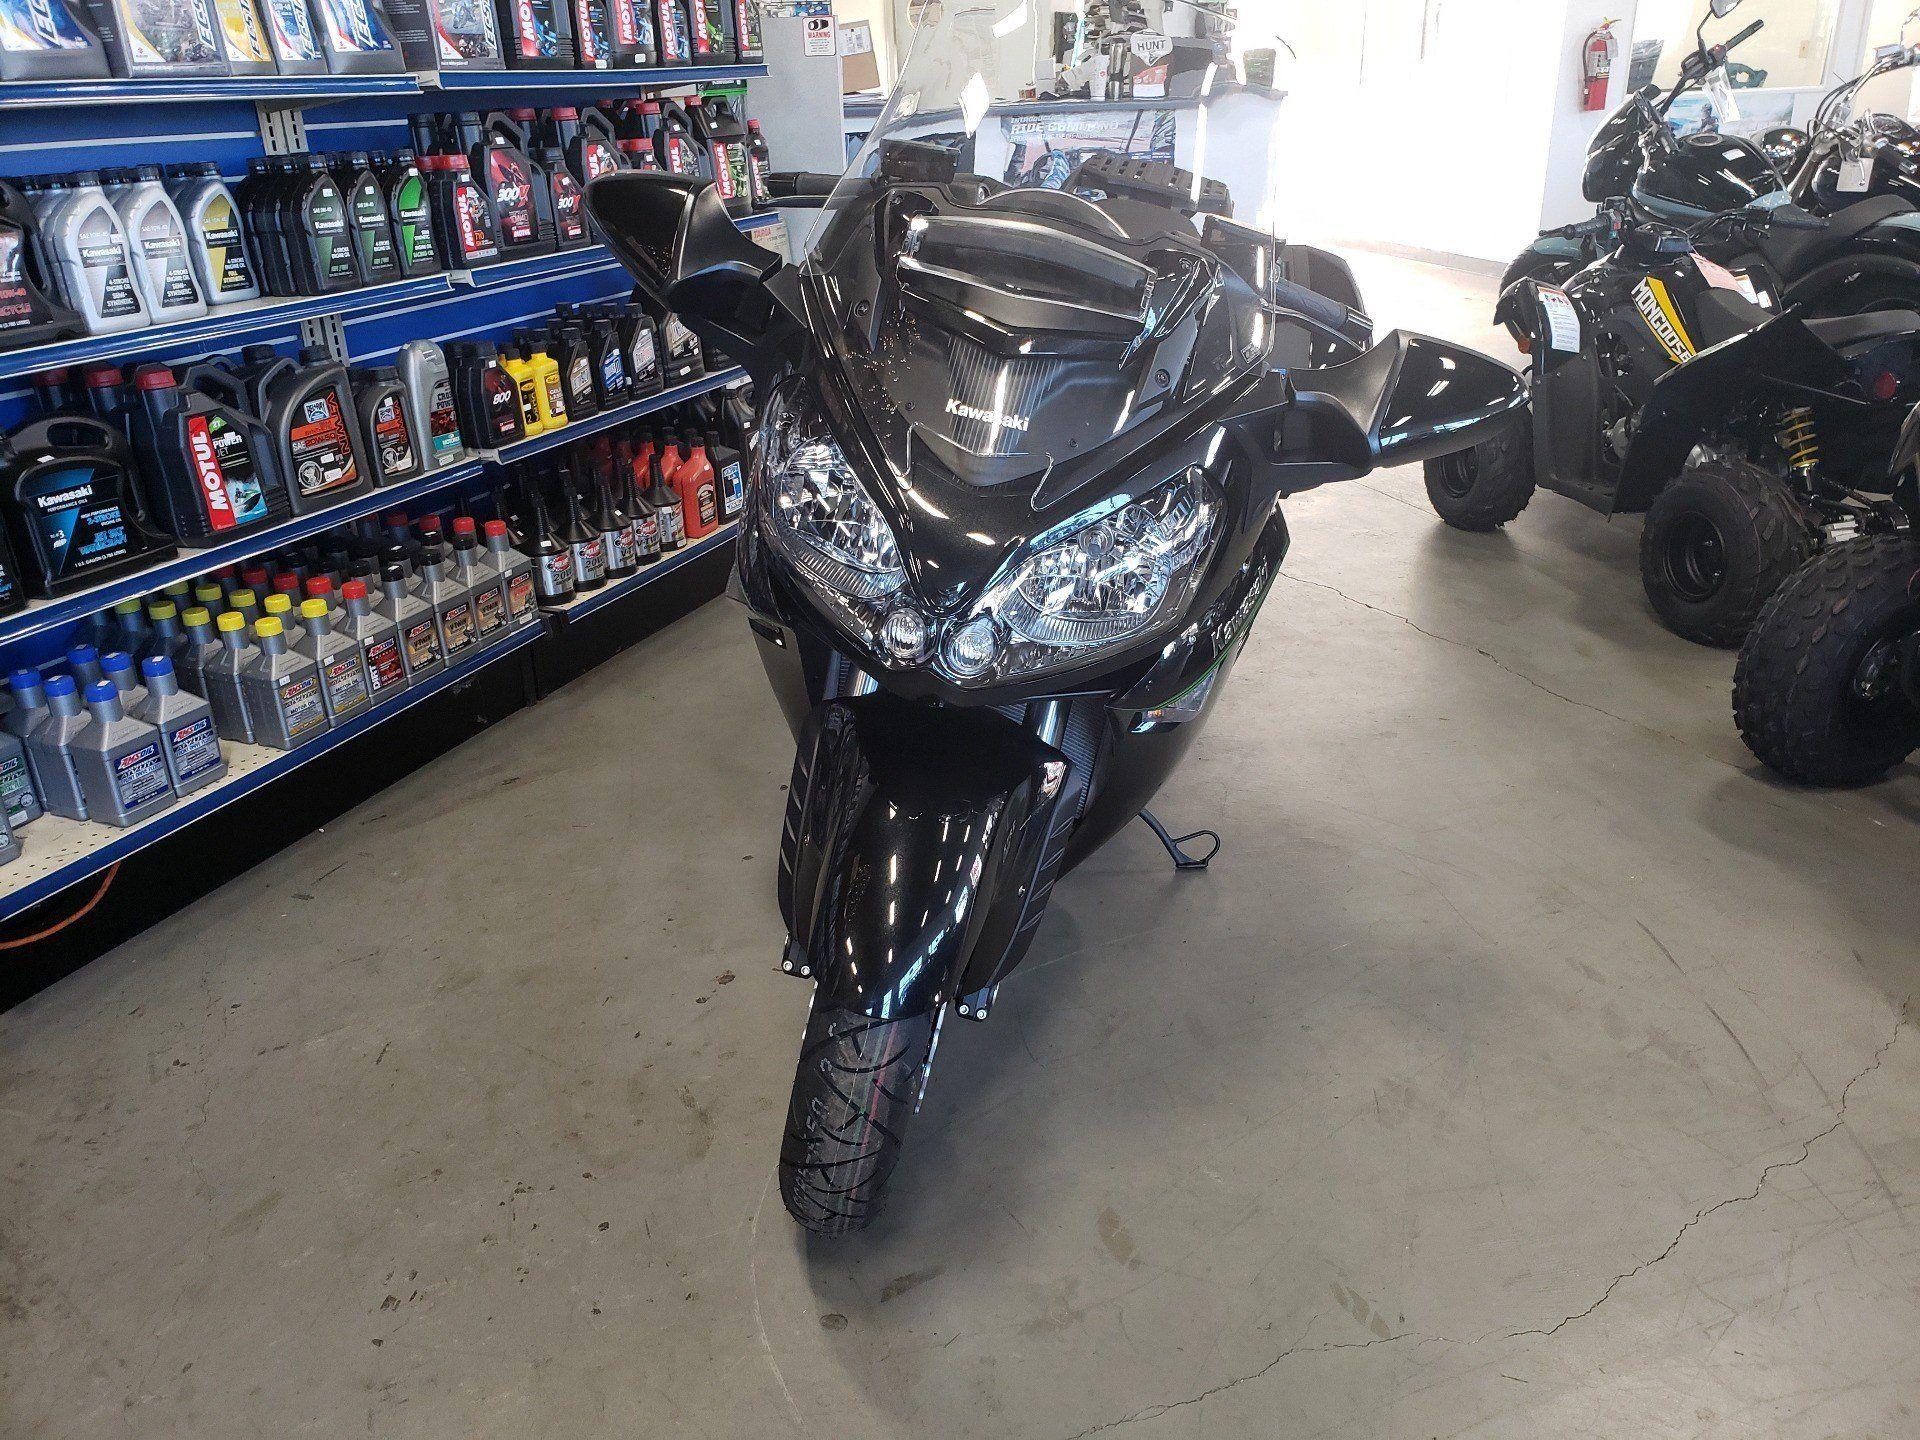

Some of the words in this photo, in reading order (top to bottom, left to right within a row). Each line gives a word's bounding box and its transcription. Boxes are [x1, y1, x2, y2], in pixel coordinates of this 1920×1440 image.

[660, 1, 677, 60] MOTUL
[737, 3, 749, 49] MOTUL
[1136, 40, 1167, 52] HUNT
[716, 144, 733, 198] MOTUL
[358, 213, 385, 223] Kawasaki
[400, 209, 427, 218] Kawasaki
[457, 194, 476, 247] MOTUL
[314, 219, 344, 230] Kawasaki
[205, 228, 239, 241] Kawasaki
[81, 246, 122, 258] Kawasaki
[143, 239, 181, 251] Kawasaki
[1630, 278, 1693, 363] MONGOOSE
[492, 390, 511, 405] 800
[945, 398, 1030, 432] Kawaaki
[212, 434, 243, 450] POWER
[292, 441, 306, 451] SAE
[216, 448, 229, 458] JET
[191, 431, 229, 510] MOTUL
[37, 484, 94, 508] Kawasaki
[86, 509, 121, 526] 2-STROKE
[173, 718, 207, 743] AMSOIL
[117, 744, 155, 771] AMSOIL
